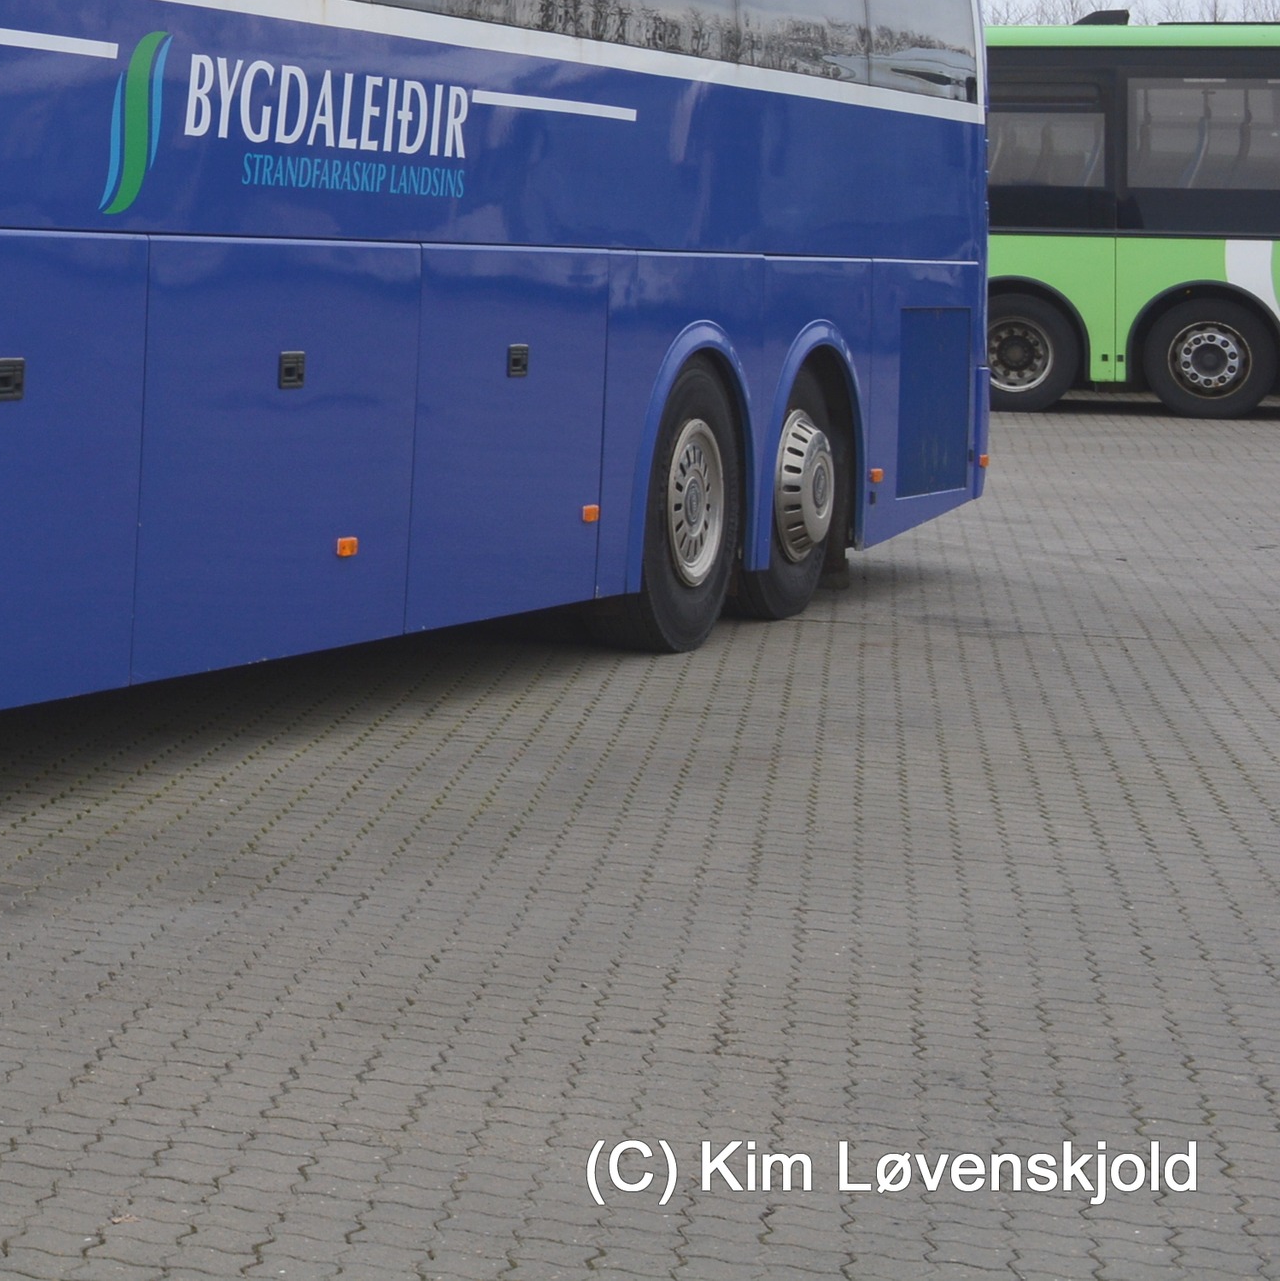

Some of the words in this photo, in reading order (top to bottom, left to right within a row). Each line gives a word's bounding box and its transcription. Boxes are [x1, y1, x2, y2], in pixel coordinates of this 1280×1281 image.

[184, 53, 467, 159] BYGDALEIÐIR
[241, 152, 386, 193] STRANDFARASKIP
[389, 165, 466, 199] LANDSINS
